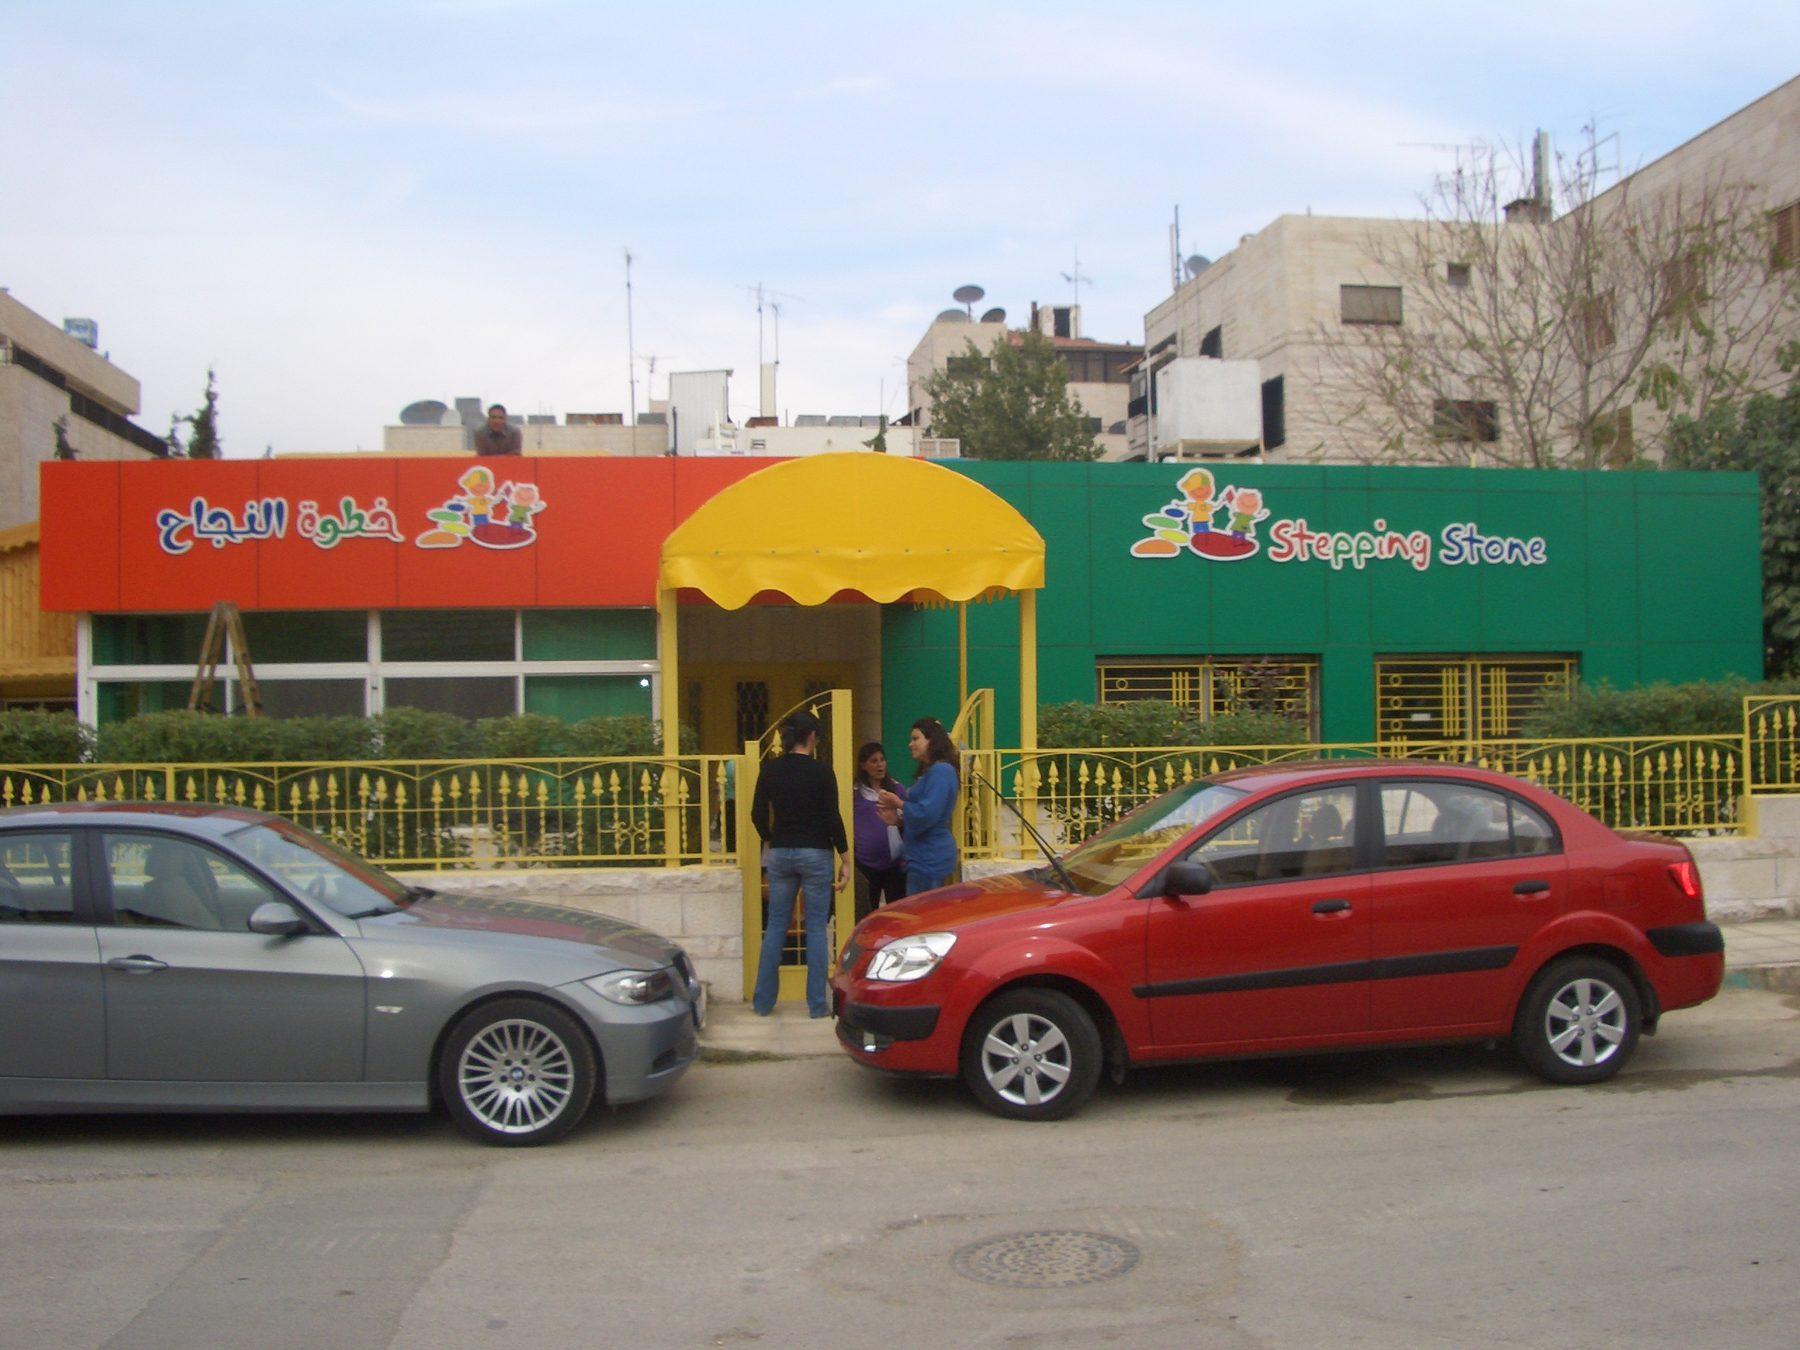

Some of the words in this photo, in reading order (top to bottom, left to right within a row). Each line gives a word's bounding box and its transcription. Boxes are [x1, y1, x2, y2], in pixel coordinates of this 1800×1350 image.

[157, 497, 287, 553] النجاح
[298, 497, 404, 547] خطوة
[1269, 518, 1431, 569] Stepping
[1440, 523, 1547, 565] Stone
